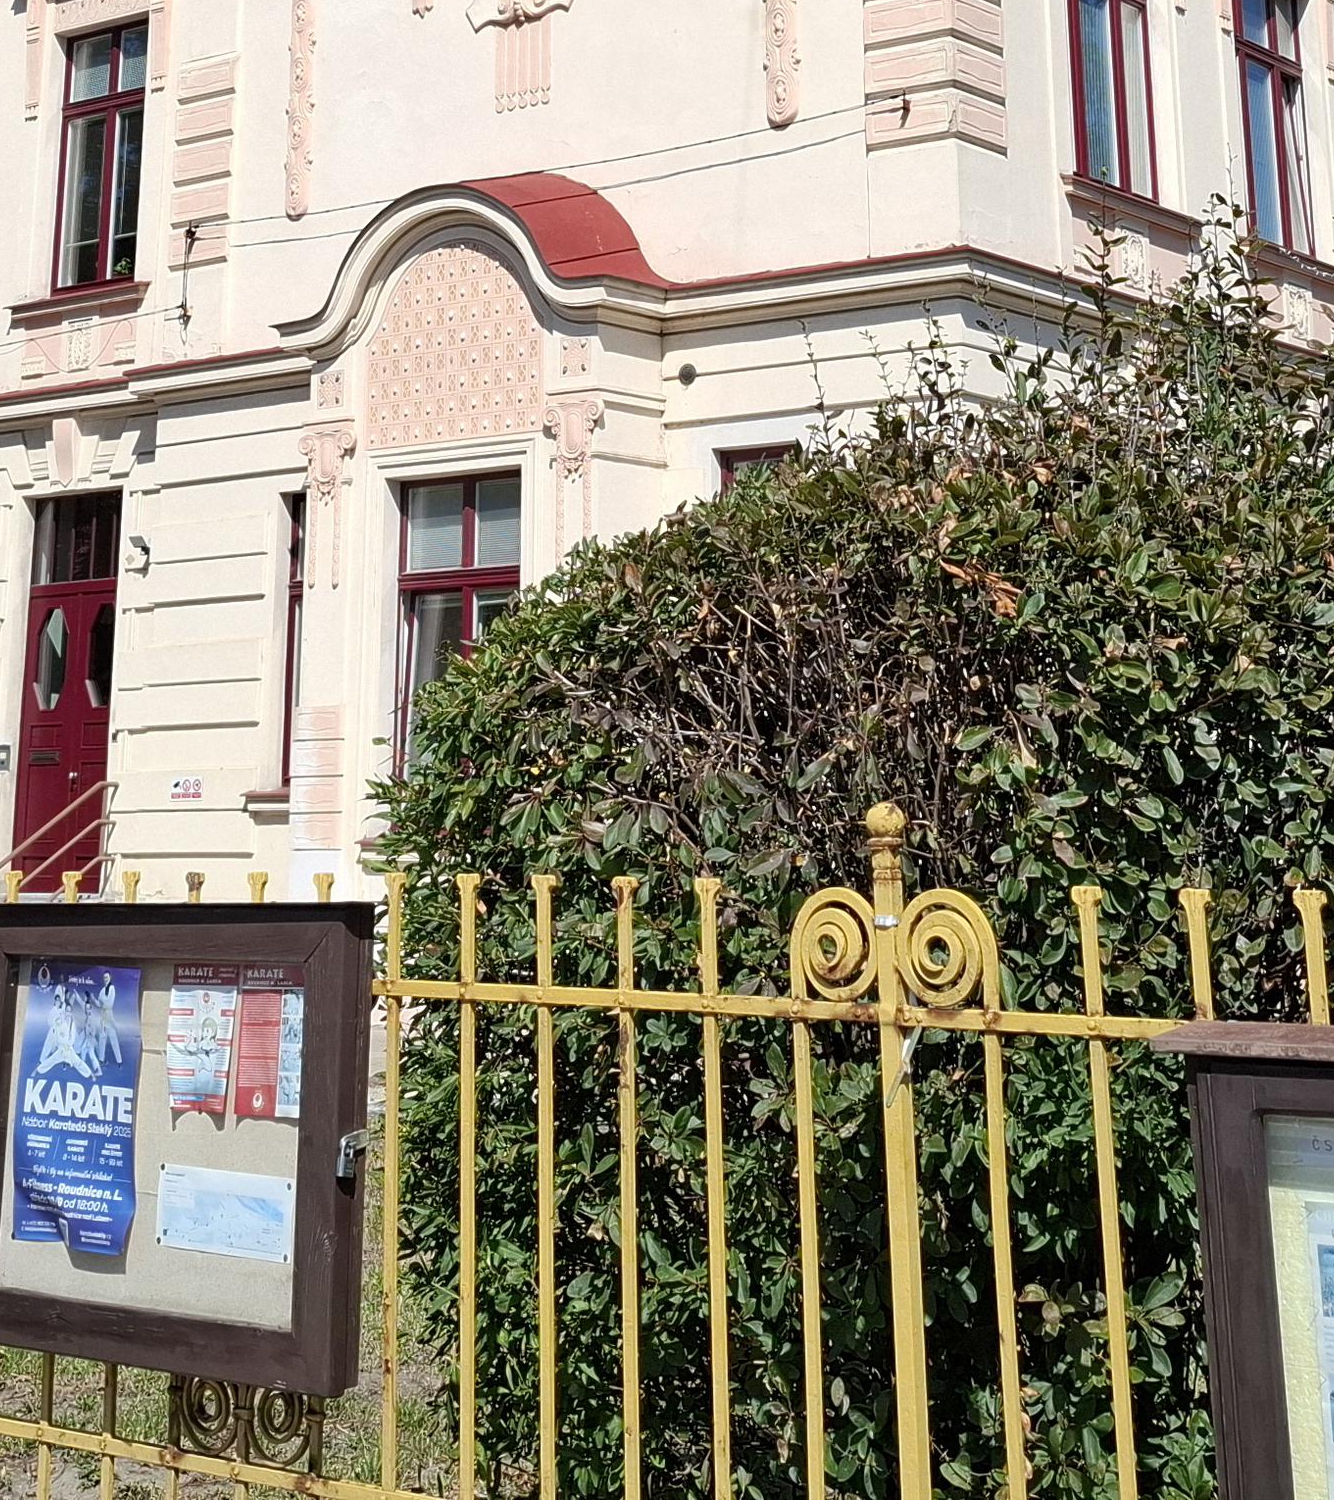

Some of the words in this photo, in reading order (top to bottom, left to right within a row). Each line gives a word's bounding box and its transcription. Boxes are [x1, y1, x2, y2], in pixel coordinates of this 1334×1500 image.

[178, 967, 213, 977] KARATE
[247, 969, 284, 978] KARATE
[23, 1078, 133, 1124] KARATE
[22, 1116, 48, 1129] Nábor
[113, 1126, 132, 1138] 2025
[58, 1183, 102, 1197] Roudnice
[103, 1190, 111, 1200] n.
[63, 1198, 76, 1208] od
[77, 1200, 101, 1212] 18:00
